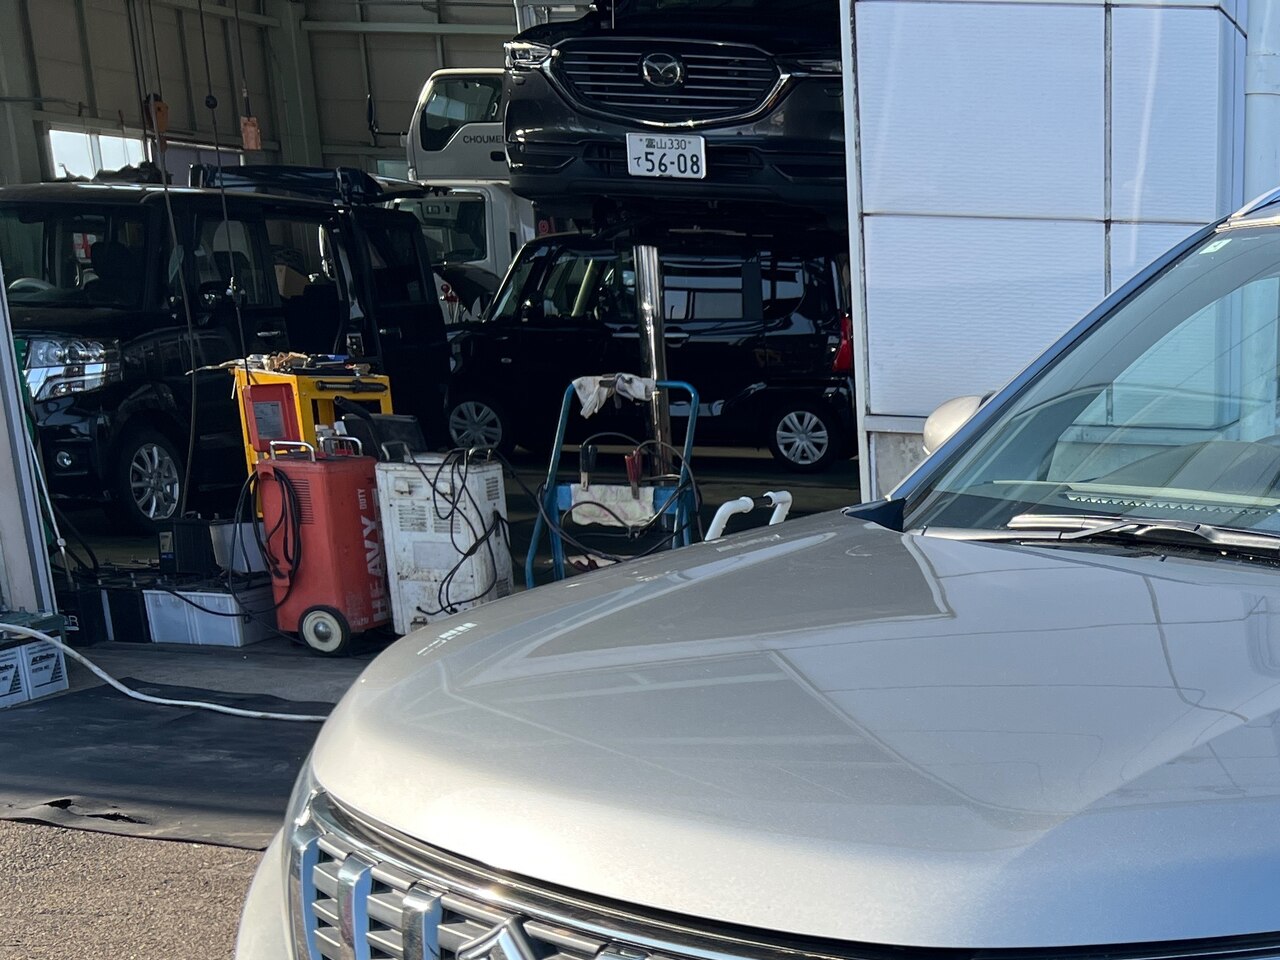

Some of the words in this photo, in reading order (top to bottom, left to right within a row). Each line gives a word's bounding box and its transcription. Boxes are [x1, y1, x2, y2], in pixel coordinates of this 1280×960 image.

[463, 135, 504, 143] CHOUME
[644, 152, 700, 175] 56-08
[357, 488, 368, 510] DUTY
[360, 515, 388, 623] HEAVY
